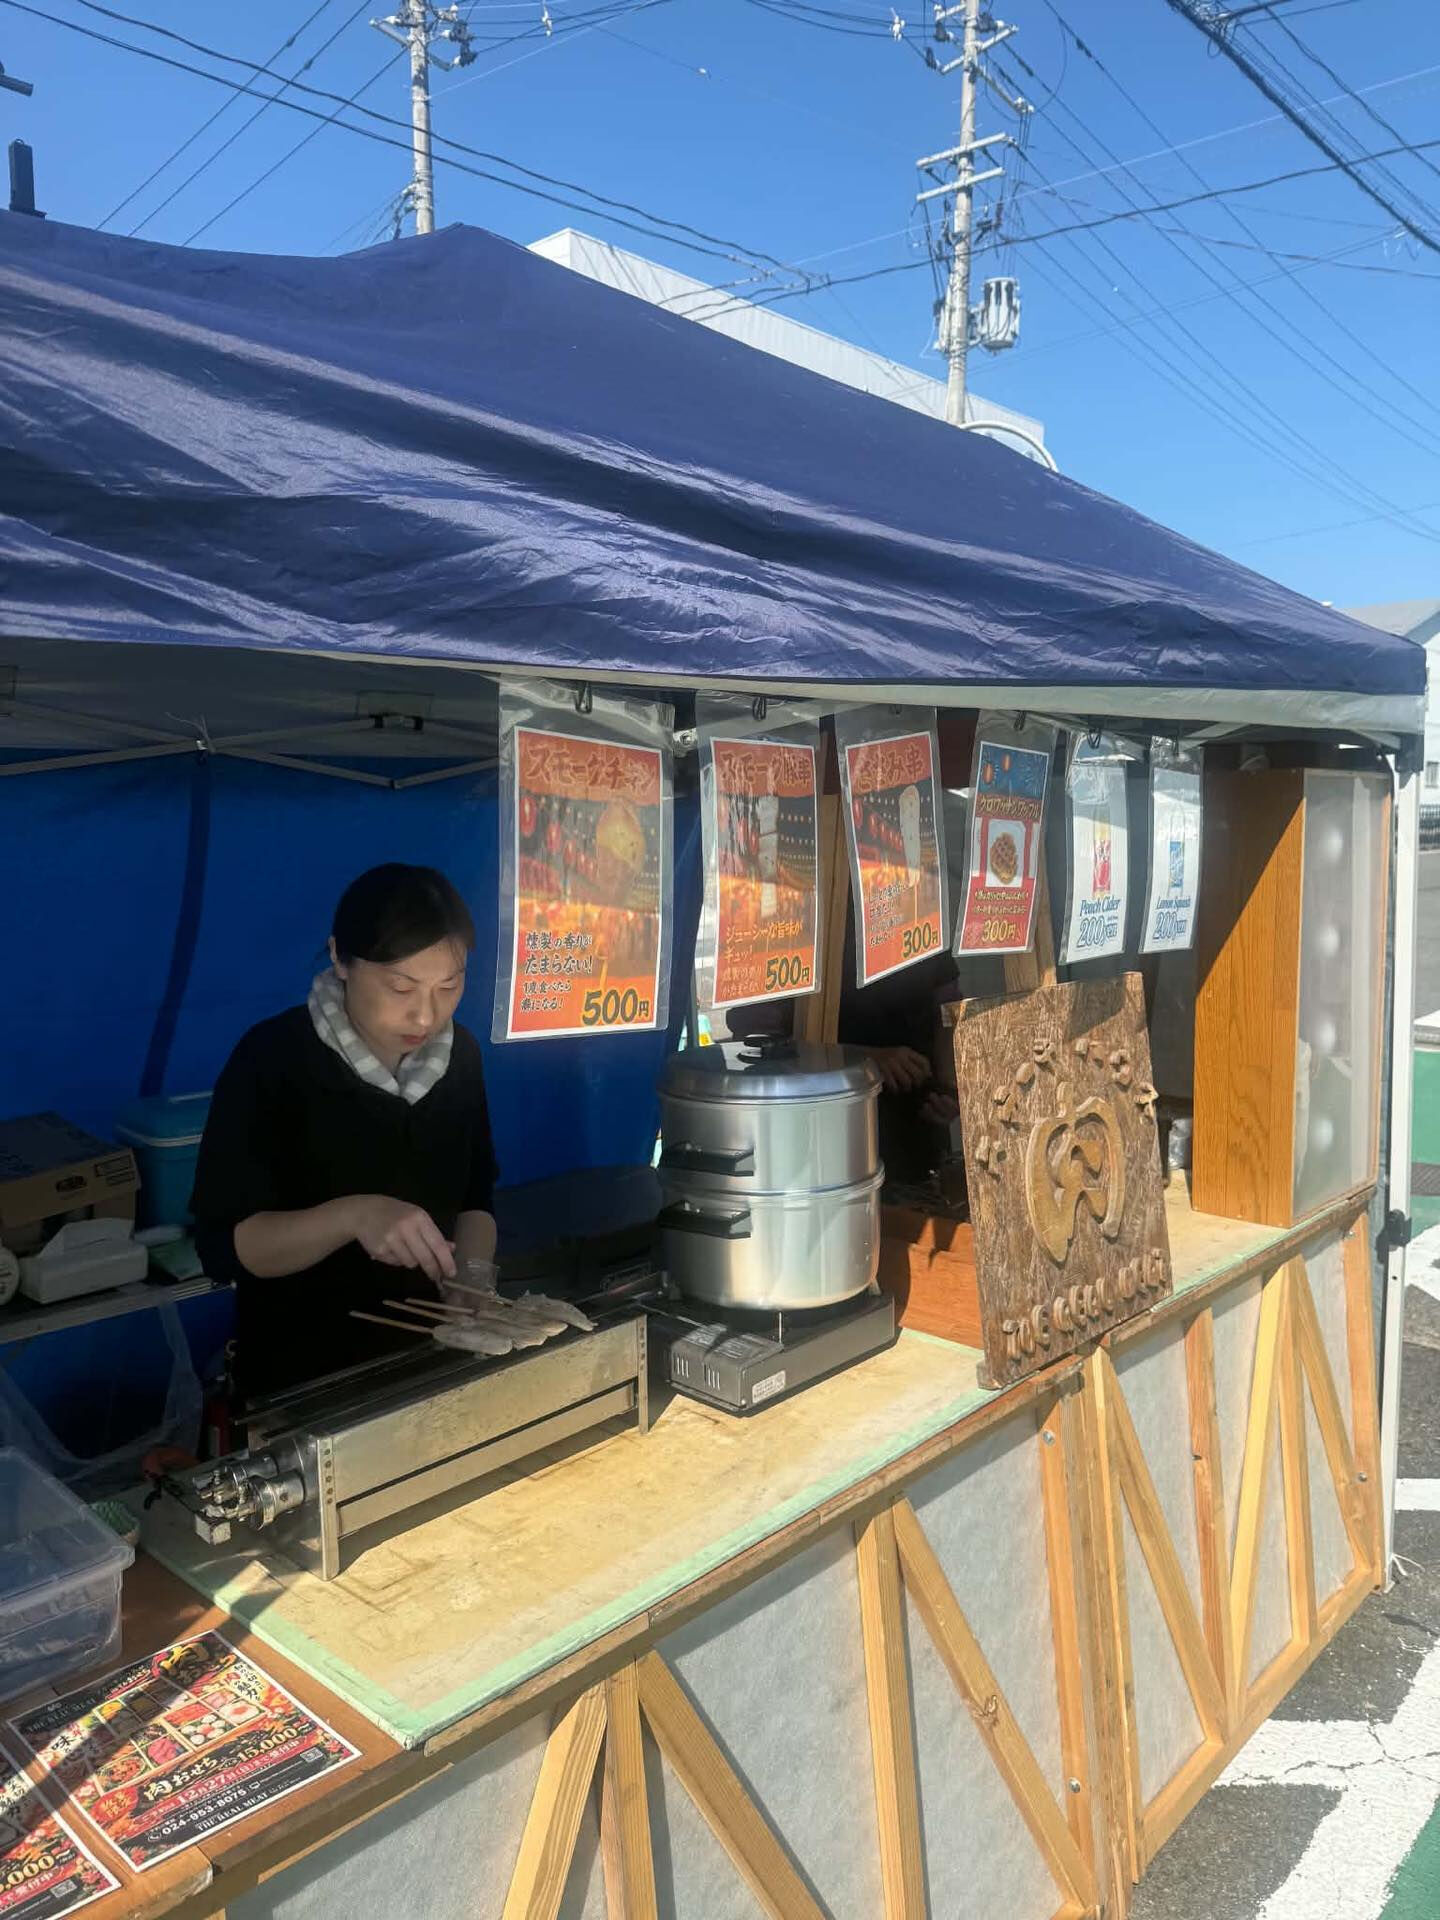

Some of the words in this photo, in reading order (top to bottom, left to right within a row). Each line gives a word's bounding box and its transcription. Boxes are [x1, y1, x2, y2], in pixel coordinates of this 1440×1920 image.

[903, 922, 939, 958] 300円
[982, 920, 1016, 942] 300円
[765, 954, 810, 991] 500円
[582, 987, 650, 1026] 500円
